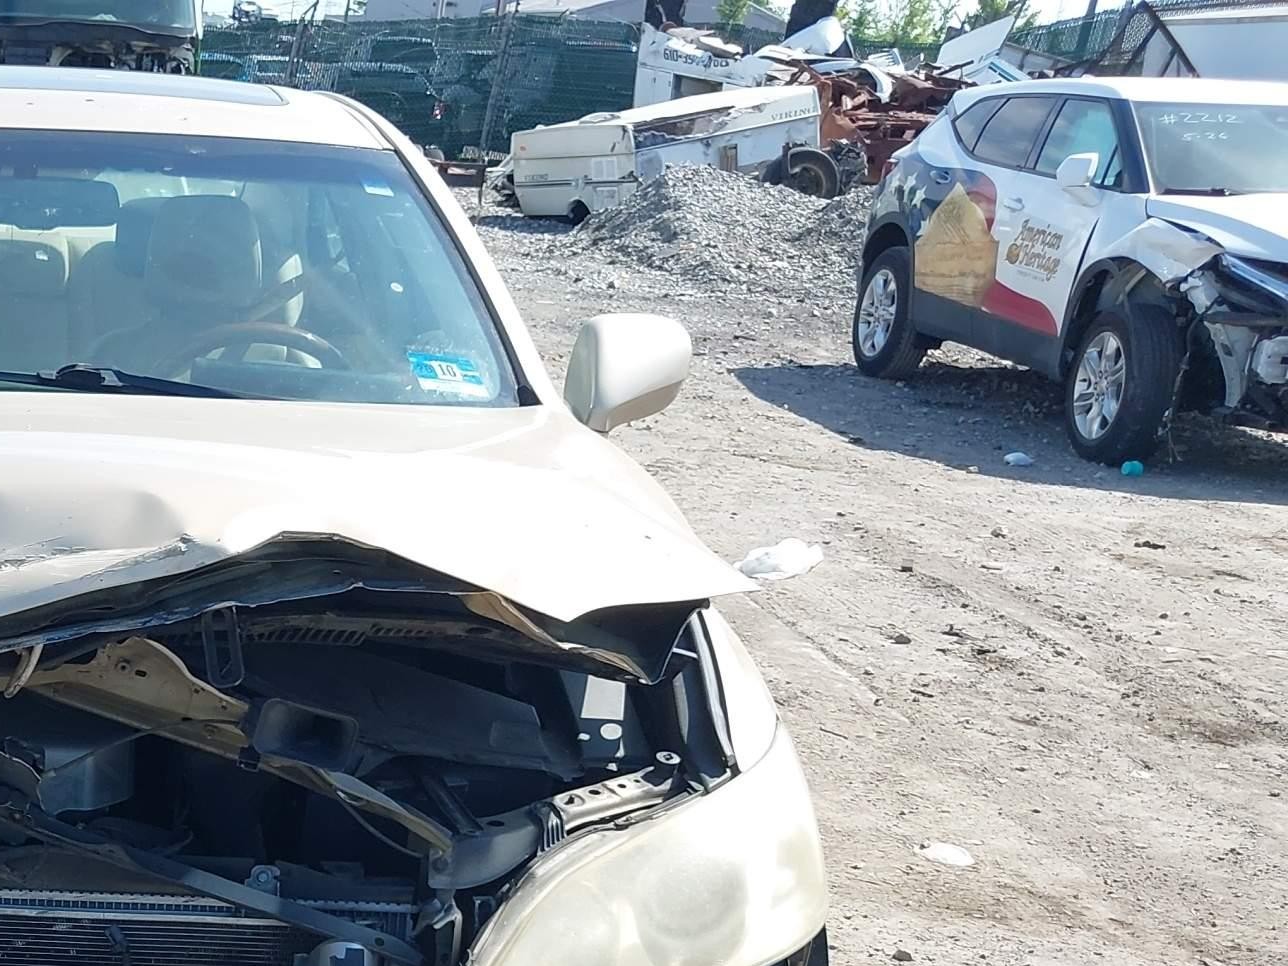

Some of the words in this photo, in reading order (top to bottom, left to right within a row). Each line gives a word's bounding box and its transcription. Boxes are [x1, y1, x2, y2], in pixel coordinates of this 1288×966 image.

[1159, 112, 1243, 125] #2212
[1014, 219, 1064, 252] American
[1018, 242, 1061, 281] Heritage
[438, 363, 457, 378] 10
